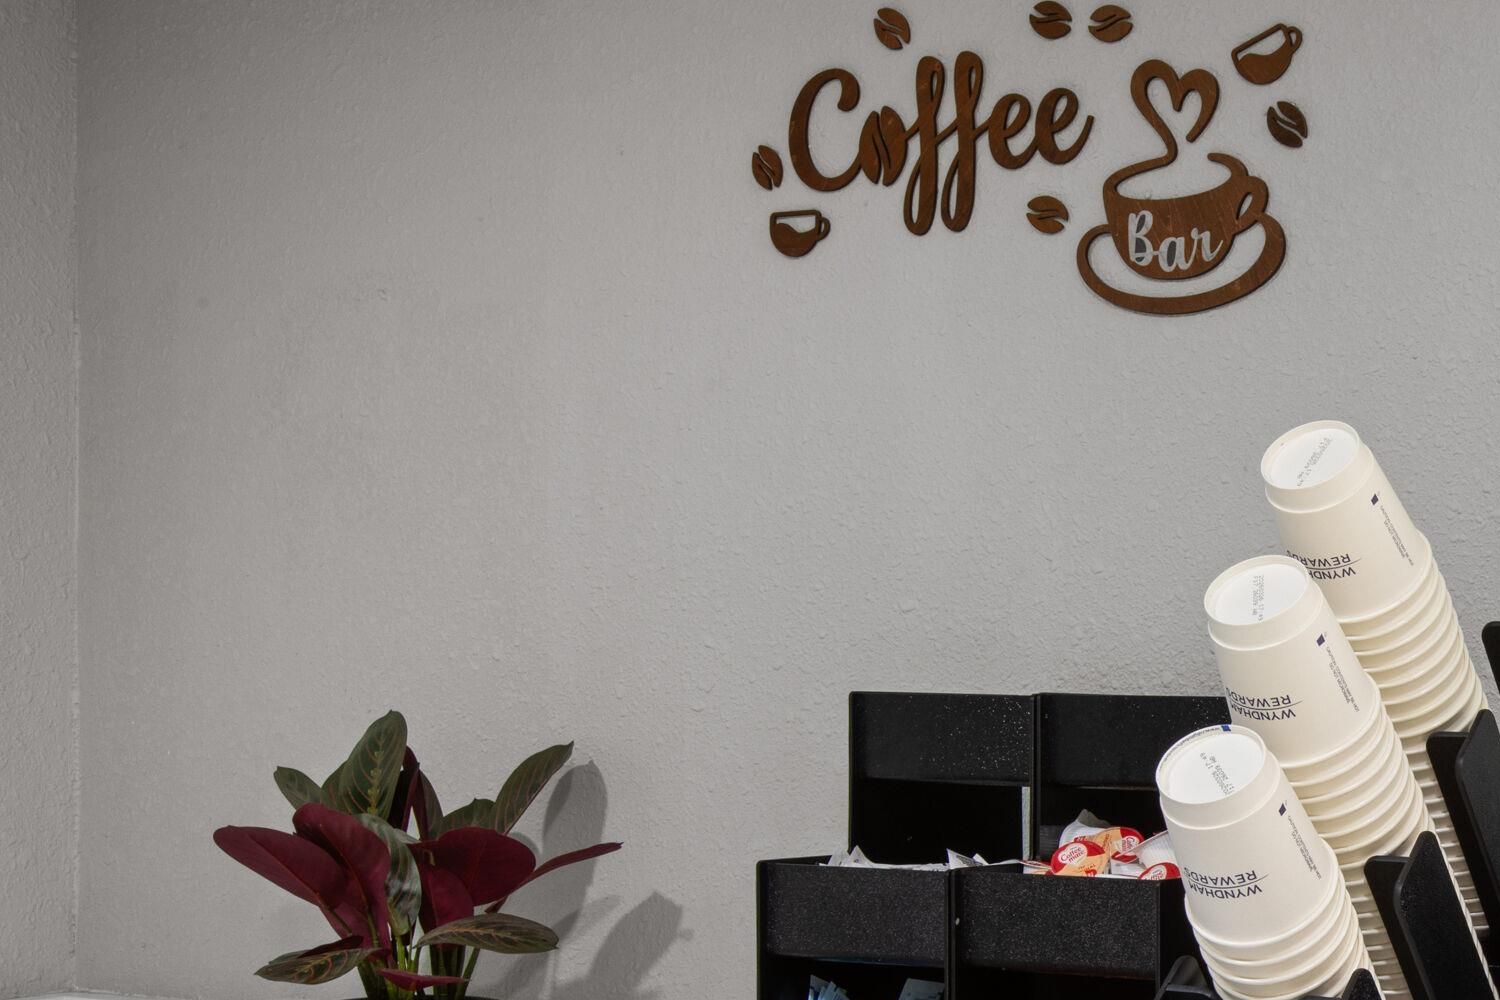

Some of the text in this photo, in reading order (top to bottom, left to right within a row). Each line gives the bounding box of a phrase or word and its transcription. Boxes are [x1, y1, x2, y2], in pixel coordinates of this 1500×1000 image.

[788, 51, 1094, 236] Coffee
[1128, 210, 1224, 273] Bar
[1061, 846, 1083, 862] Coffee
[1184, 867, 1257, 886] REWARDS
[1188, 880, 1263, 899] WYNDHAM
